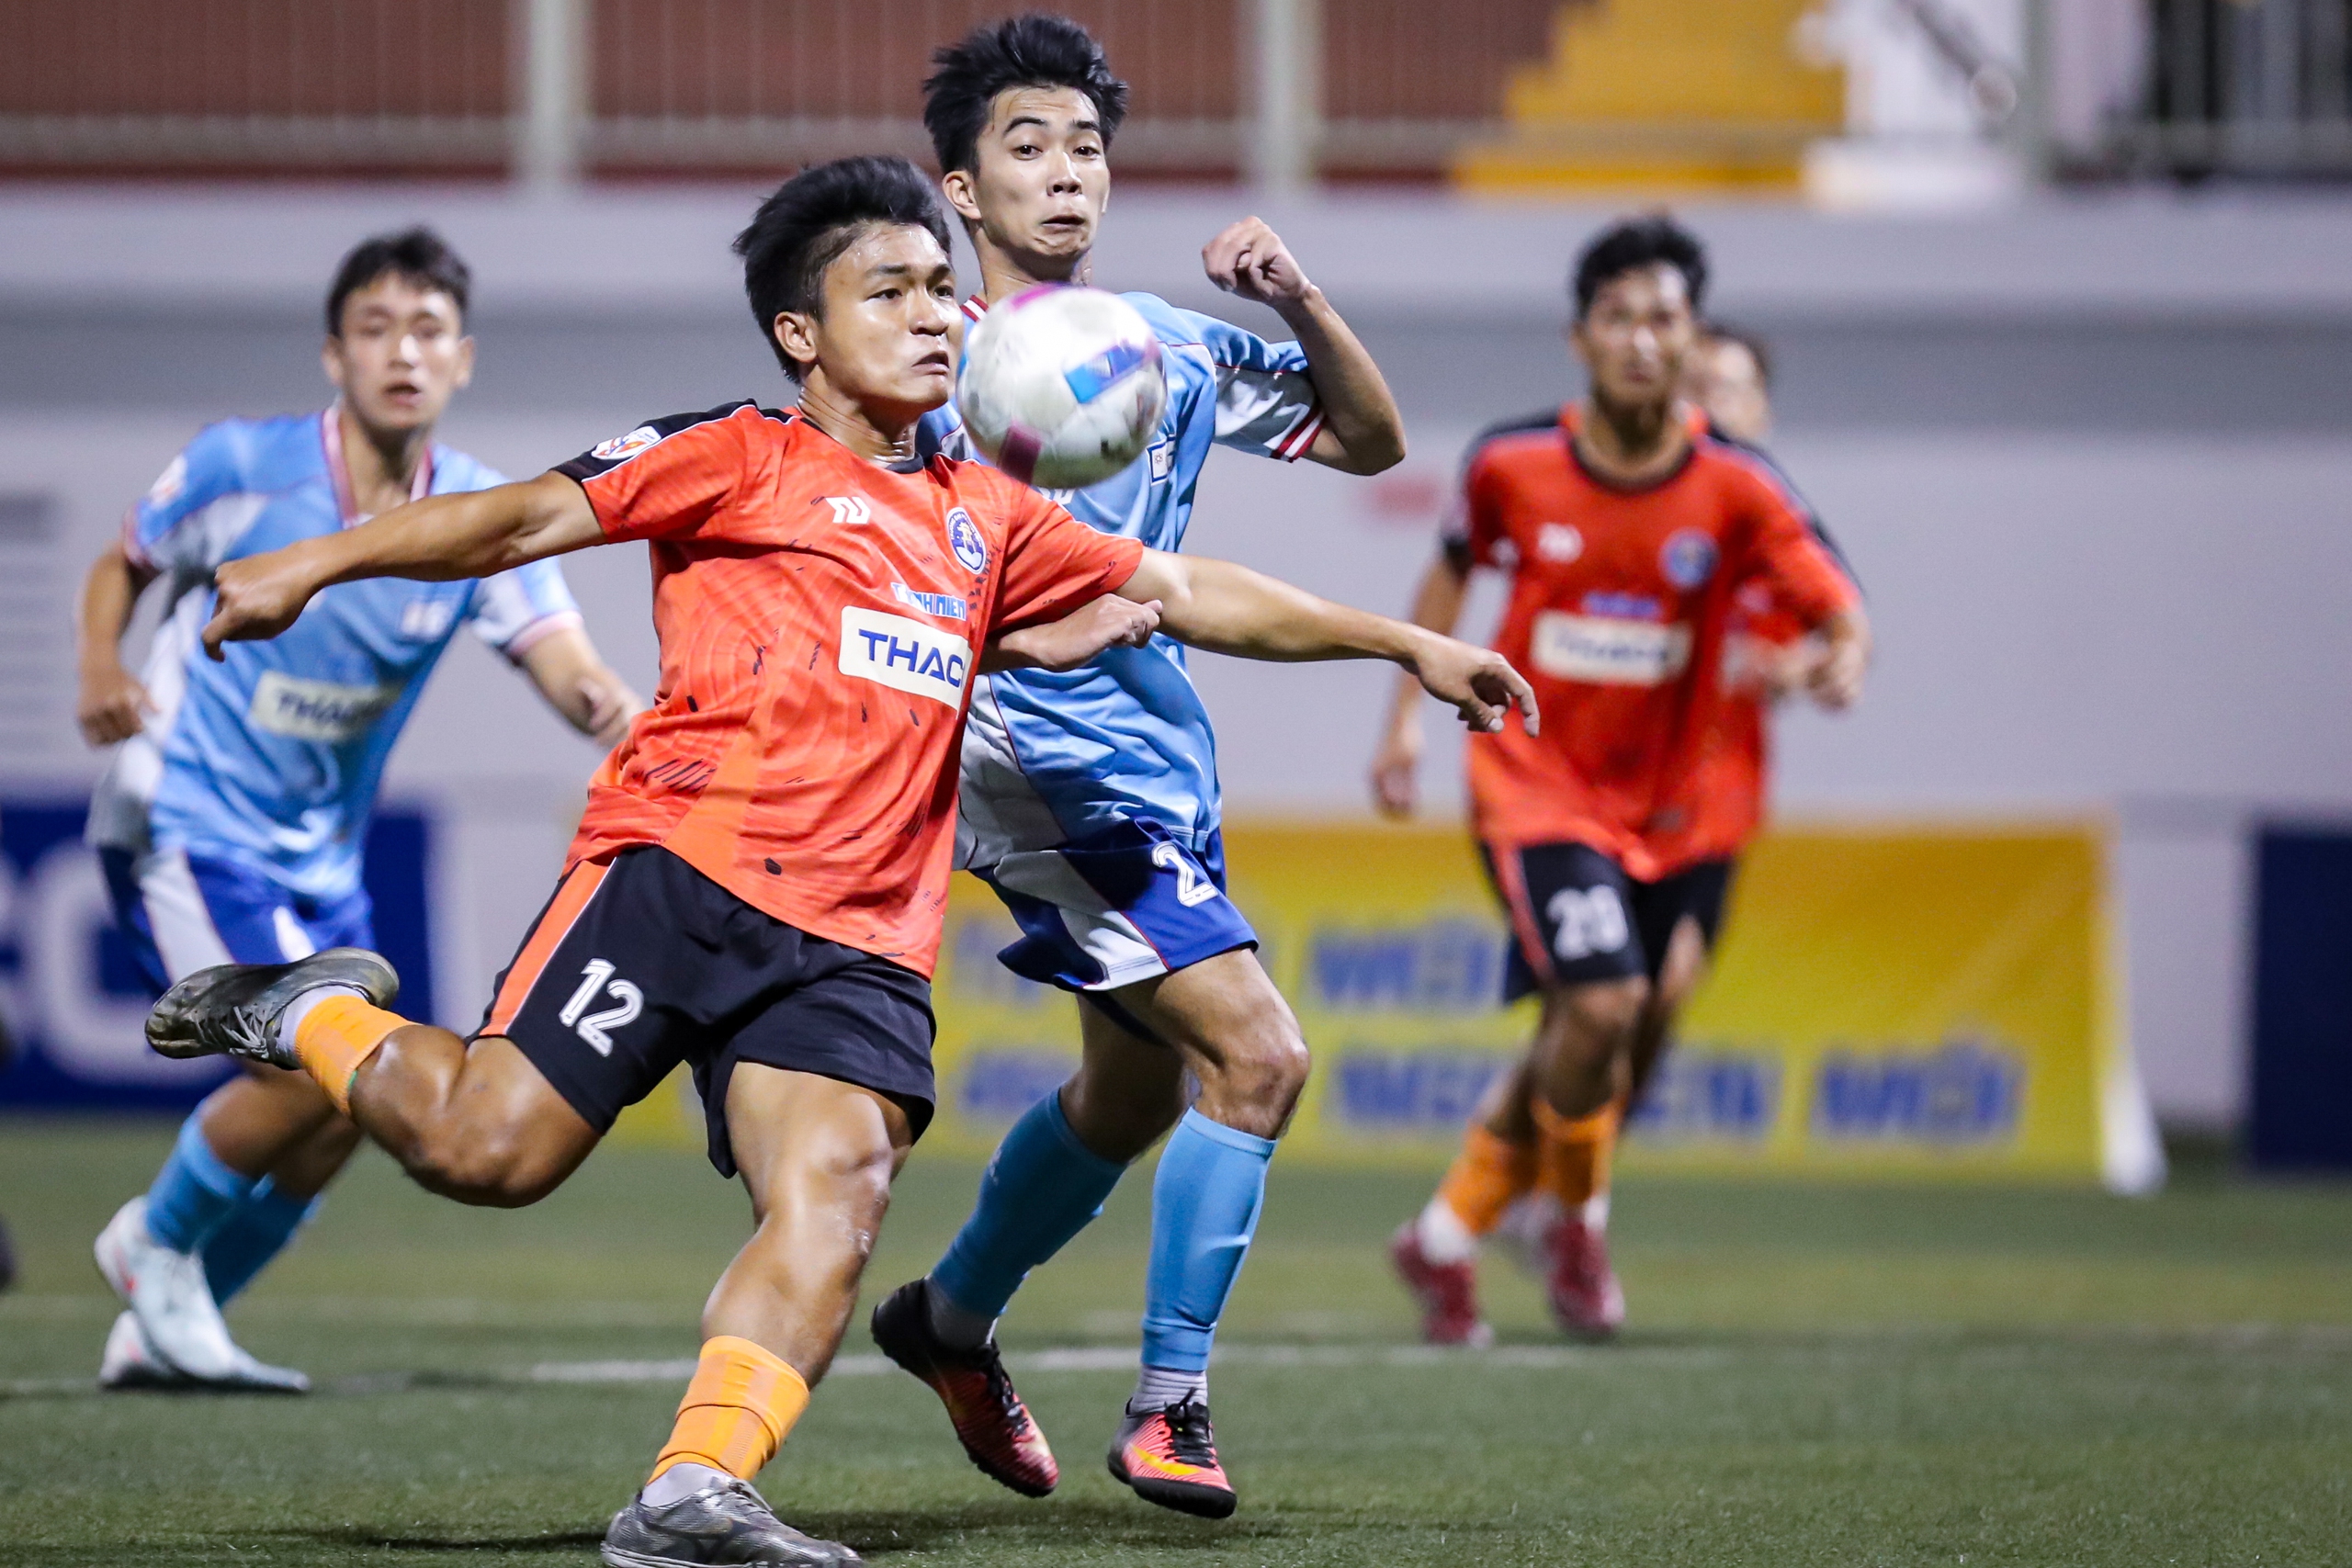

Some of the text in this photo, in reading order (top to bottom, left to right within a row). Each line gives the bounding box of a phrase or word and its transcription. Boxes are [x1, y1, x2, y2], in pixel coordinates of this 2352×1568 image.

[858, 628, 965, 689] THAC
[1151, 840, 1218, 908] 2
[558, 958, 644, 1057] 12
